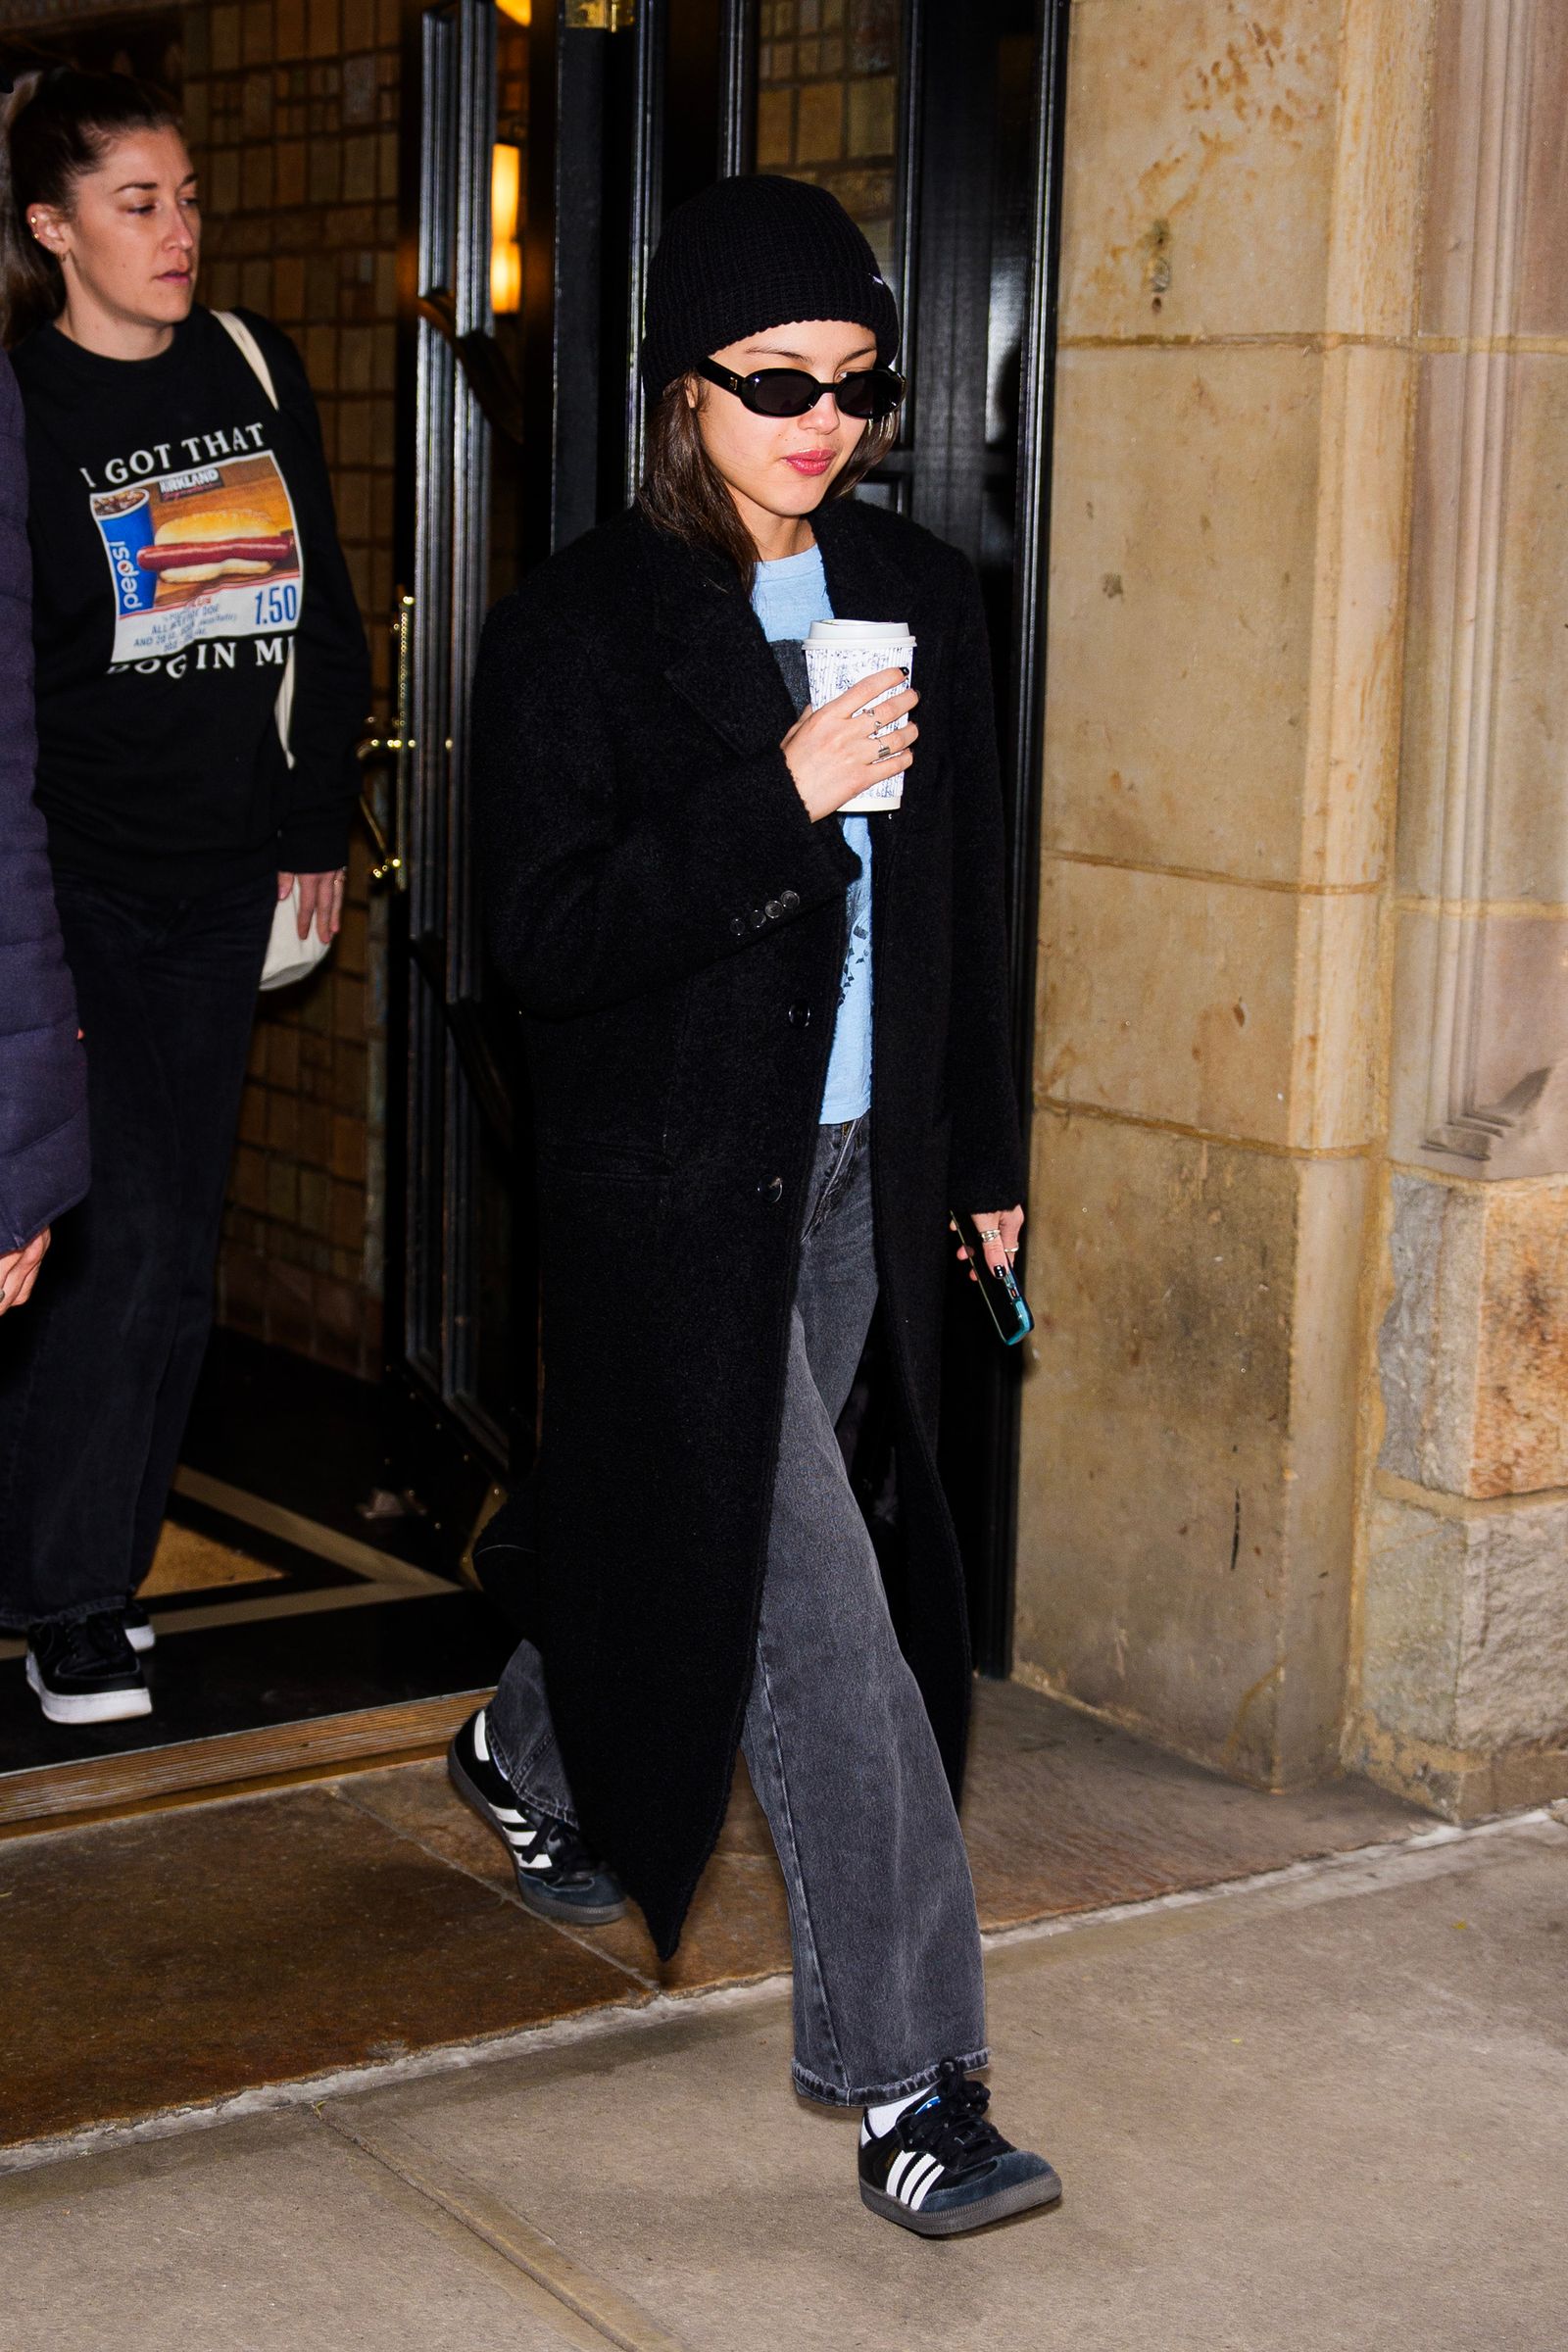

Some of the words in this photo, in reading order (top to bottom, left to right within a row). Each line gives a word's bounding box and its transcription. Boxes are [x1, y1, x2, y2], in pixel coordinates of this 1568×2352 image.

[79, 467, 96, 488] I
[104, 443, 172, 484] GOT
[180, 421, 264, 464] THAT
[159, 468, 220, 494] KIRKLAND
[108, 541, 143, 610] pepsi
[255, 585, 297, 625] 1.50
[196, 642, 236, 669] IN
